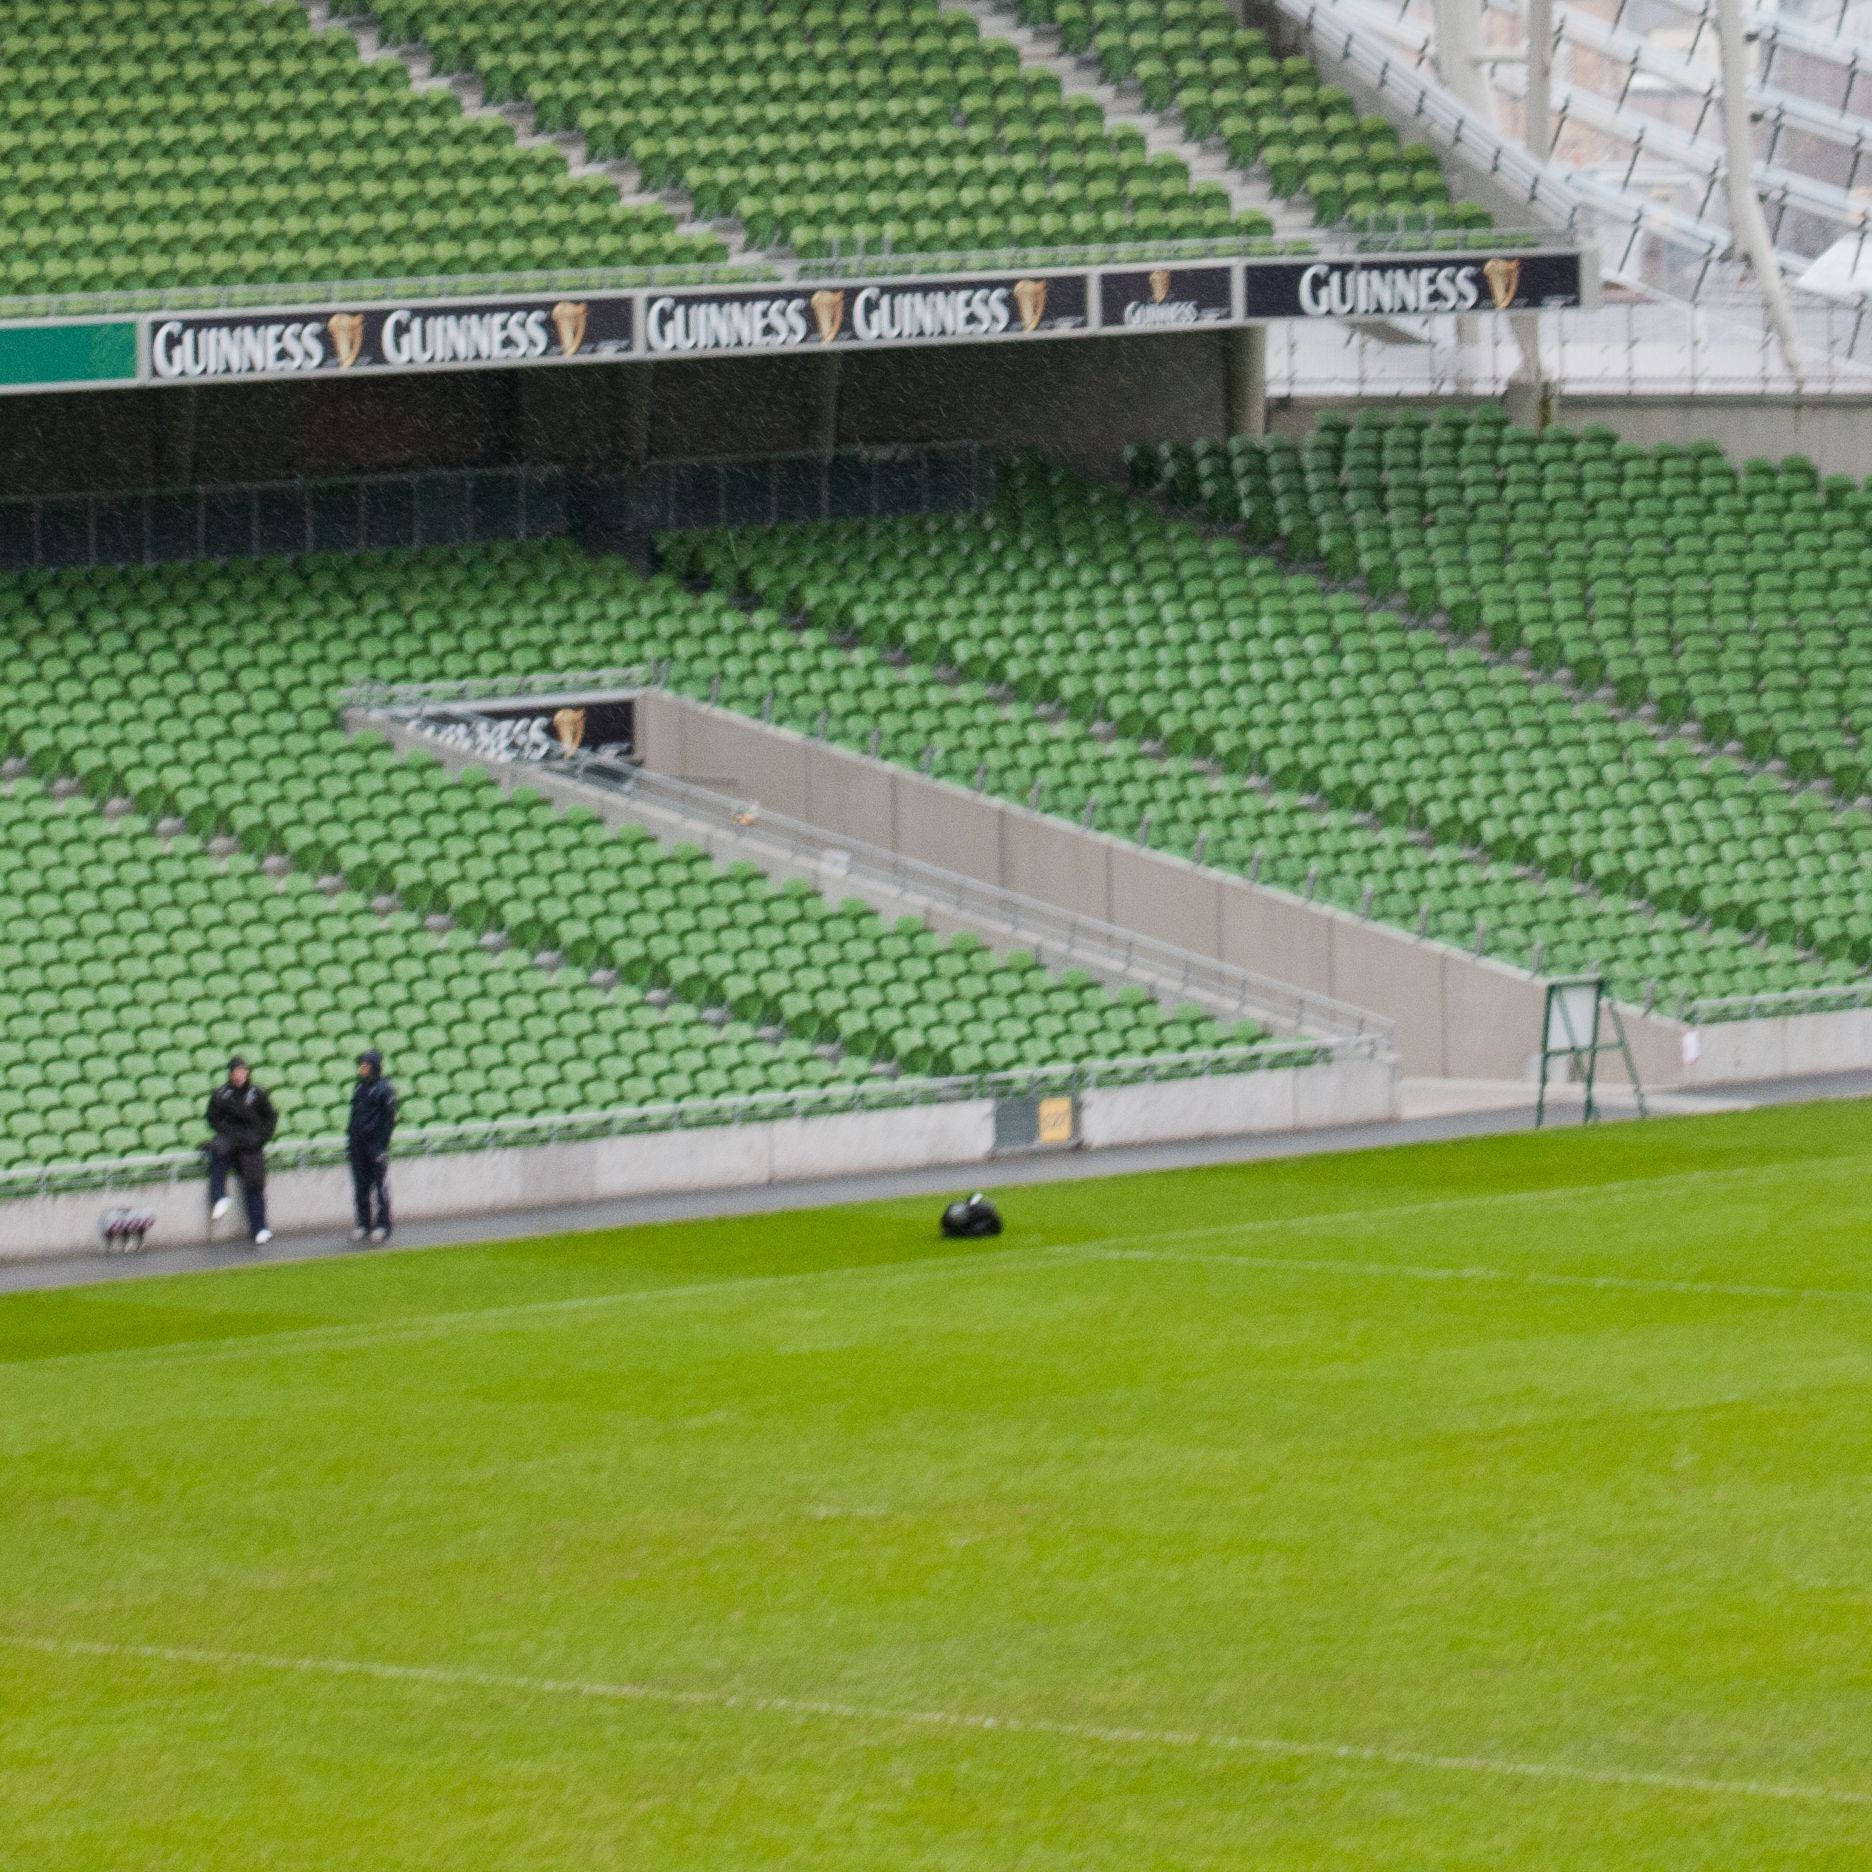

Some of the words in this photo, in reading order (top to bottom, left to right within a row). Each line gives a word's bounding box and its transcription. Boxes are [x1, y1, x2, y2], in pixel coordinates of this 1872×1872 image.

[852, 286, 1012, 342] GUINNESS
[1298, 264, 1480, 316] GUINNESS
[152, 320, 327, 378] GUINNESS
[381, 309, 549, 366] GUINNESS
[647, 296, 808, 351] GUINNESS
